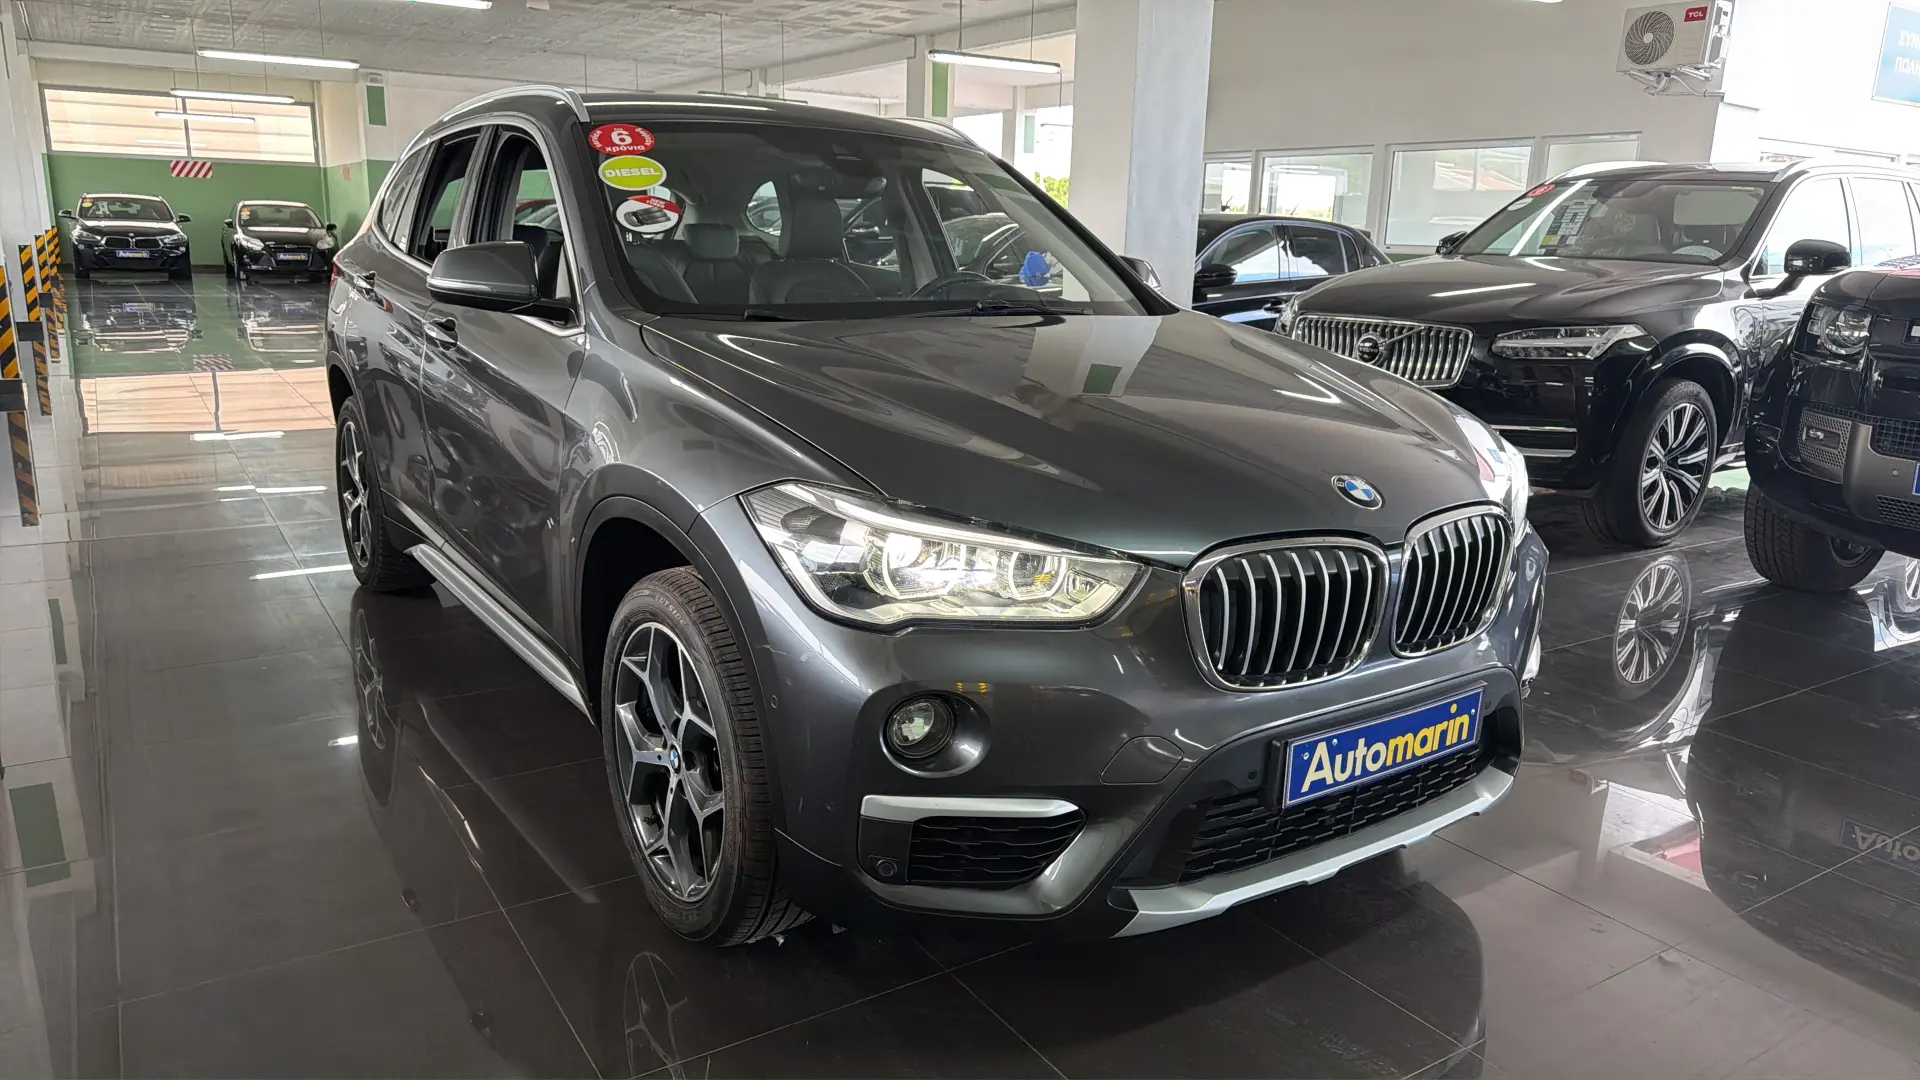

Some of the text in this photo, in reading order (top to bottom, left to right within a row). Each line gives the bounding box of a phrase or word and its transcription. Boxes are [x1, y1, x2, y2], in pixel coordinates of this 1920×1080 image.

[1688, 10, 1704, 18] TCL
[611, 130, 632, 145] 6
[605, 145, 645, 153] χρόνια
[605, 168, 660, 178] DIESEL
[1300, 703, 1470, 793] Automarin
